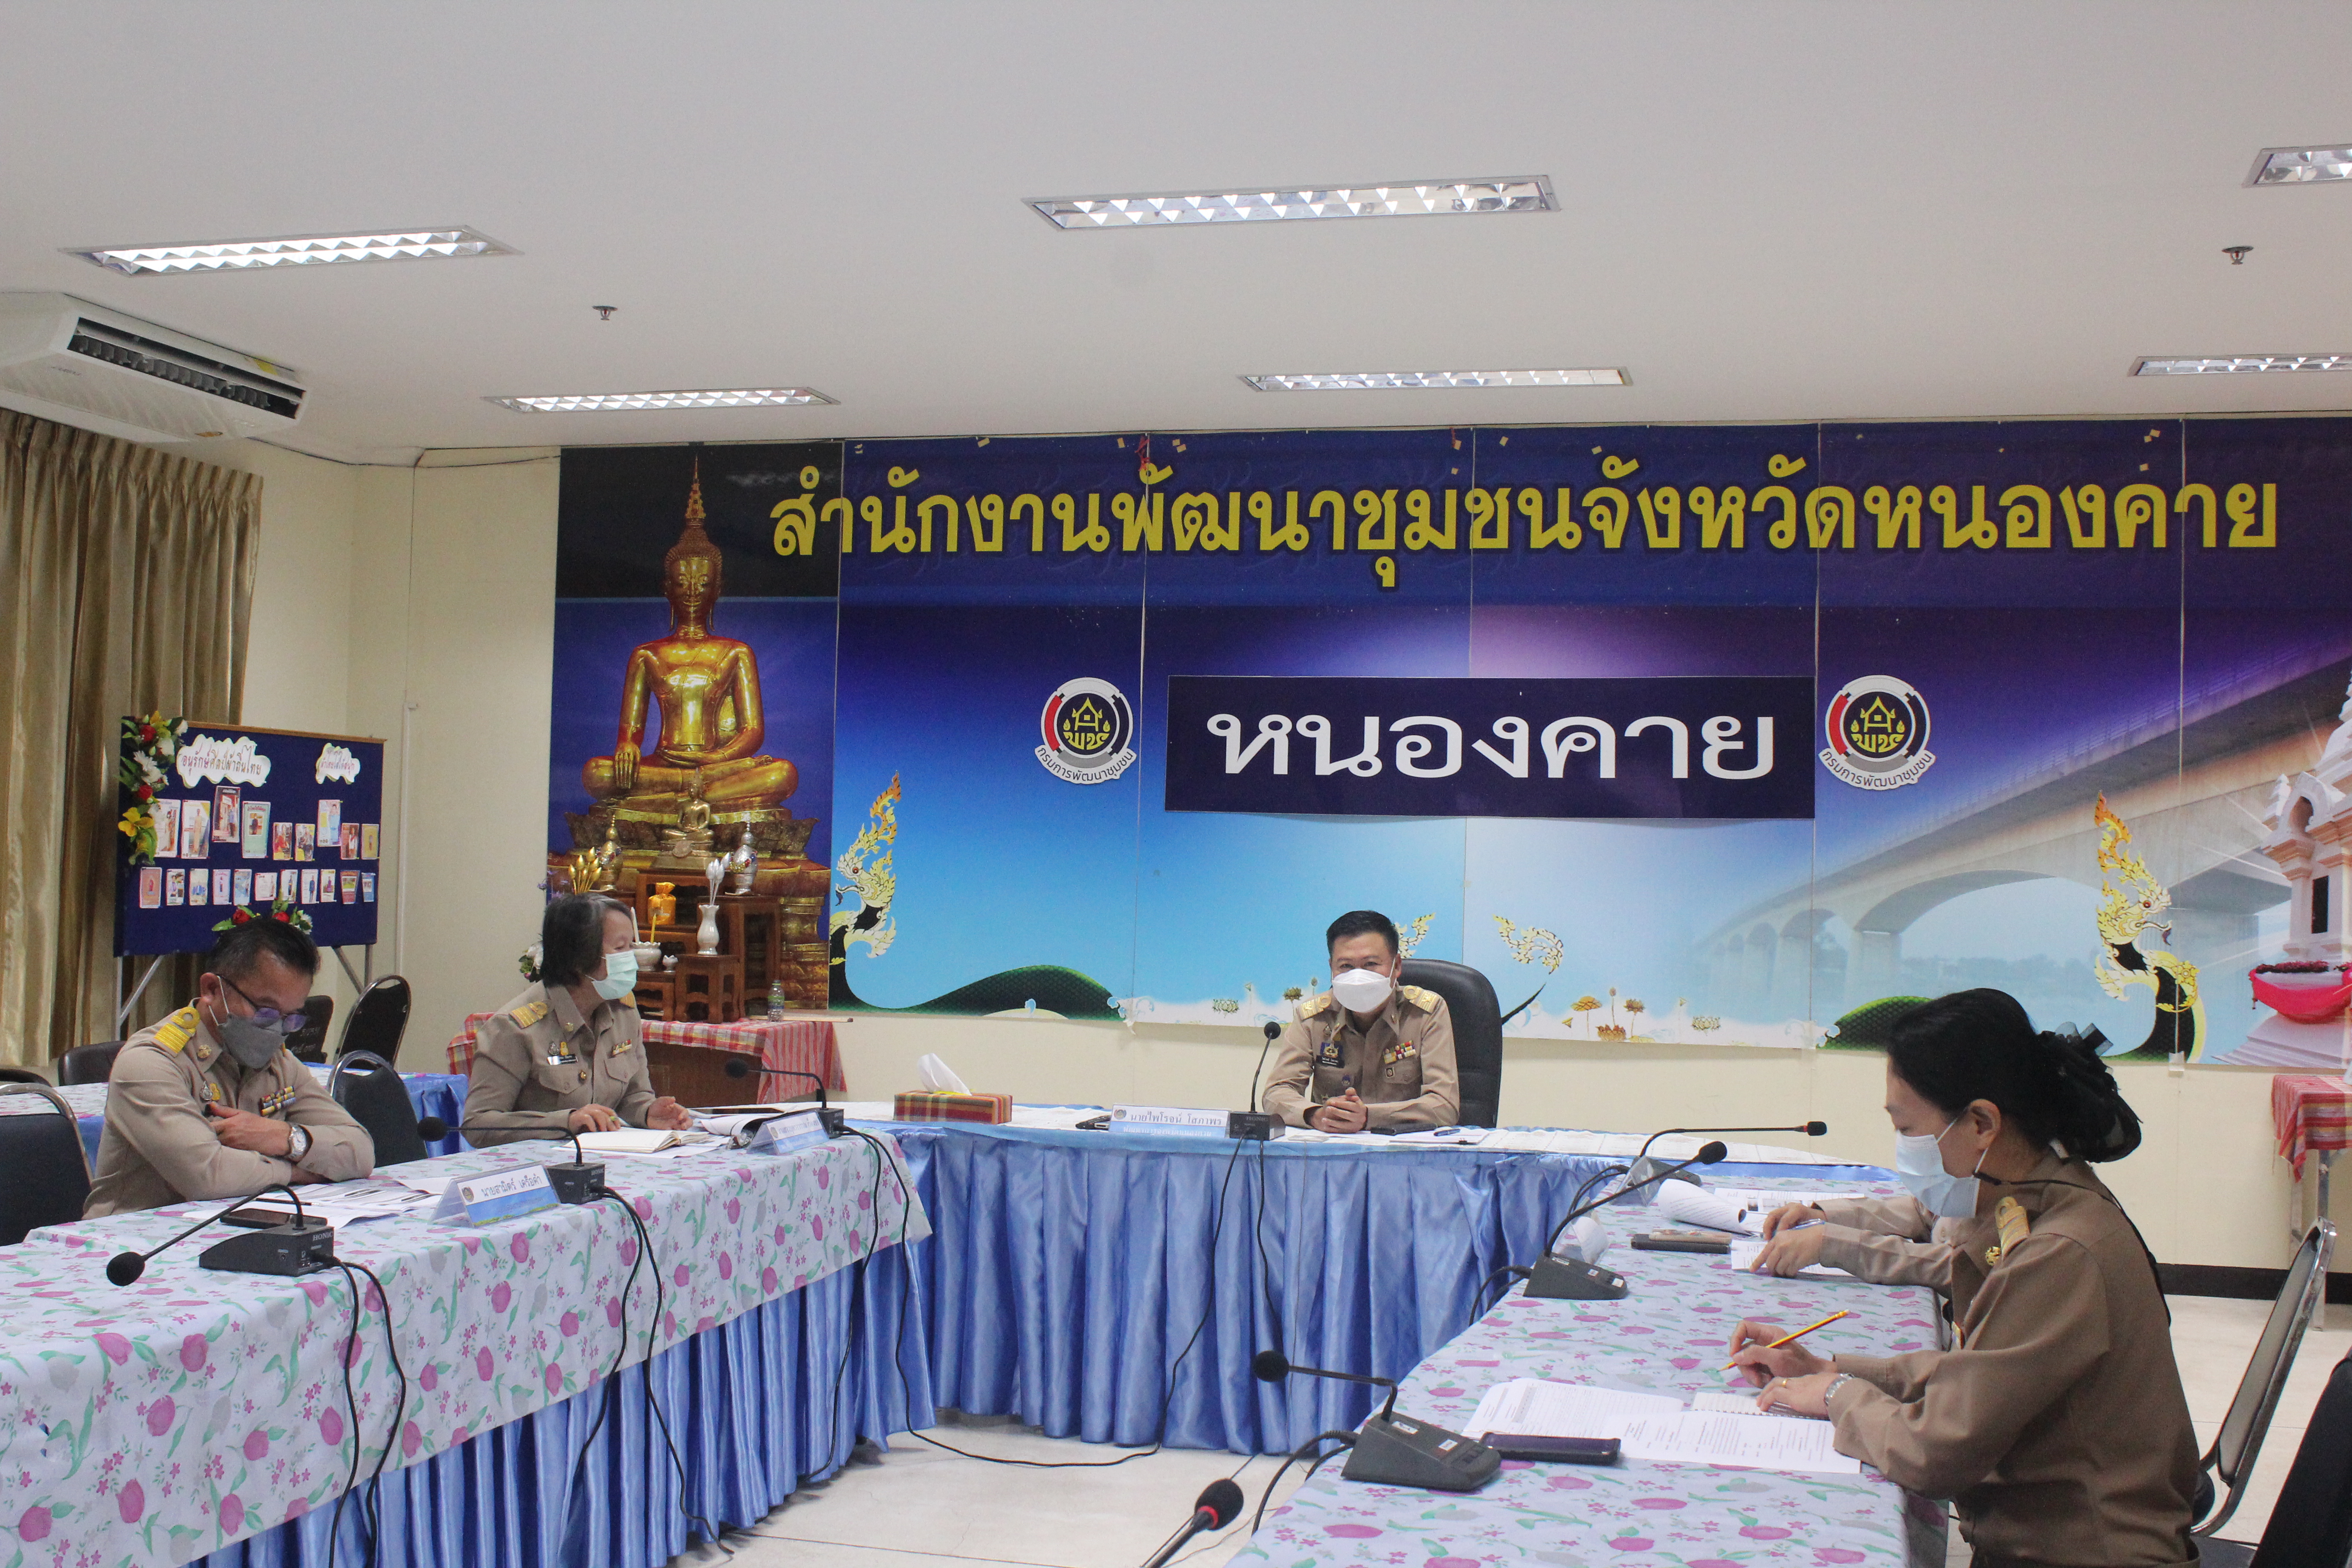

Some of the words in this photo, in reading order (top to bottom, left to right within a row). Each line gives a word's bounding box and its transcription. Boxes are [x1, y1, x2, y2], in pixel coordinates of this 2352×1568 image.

[770, 454, 2277, 588] สำนักงานพัฒนาชุมชนจังหวัดหนองคาย
[1037, 747, 1133, 781] กรมการพัฒนาชุมชน
[1206, 714, 1774, 779] หนองคาย
[1822, 751, 1932, 787] กรมการพัฒนาชุมชน
[313, 1231, 333, 1241] HONIC
